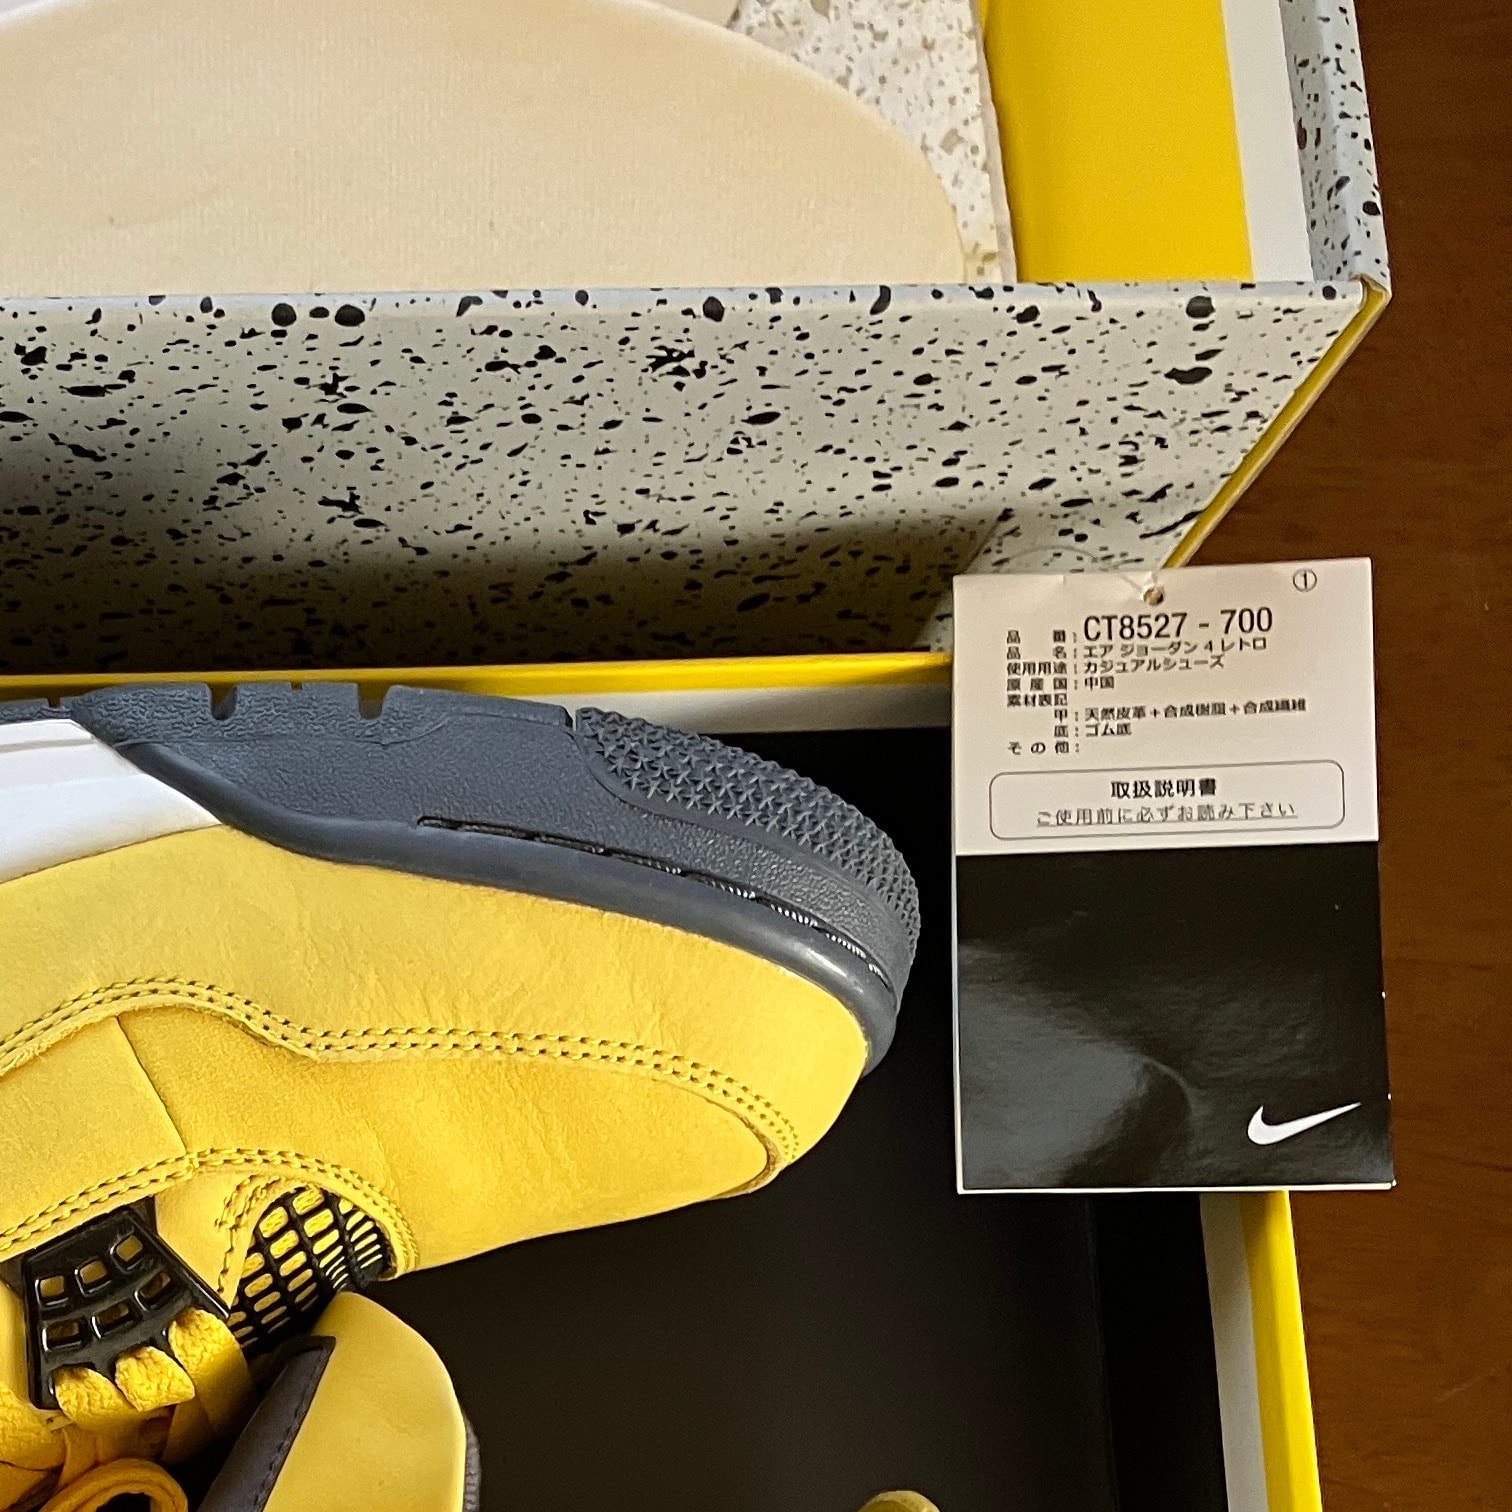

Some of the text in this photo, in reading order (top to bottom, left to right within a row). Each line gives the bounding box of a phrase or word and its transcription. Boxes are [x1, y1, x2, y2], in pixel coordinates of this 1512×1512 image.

[1084, 612, 1187, 641] CT8527
[1220, 607, 1273, 634] 700
[1111, 778, 1216, 799] 取扱説明書
